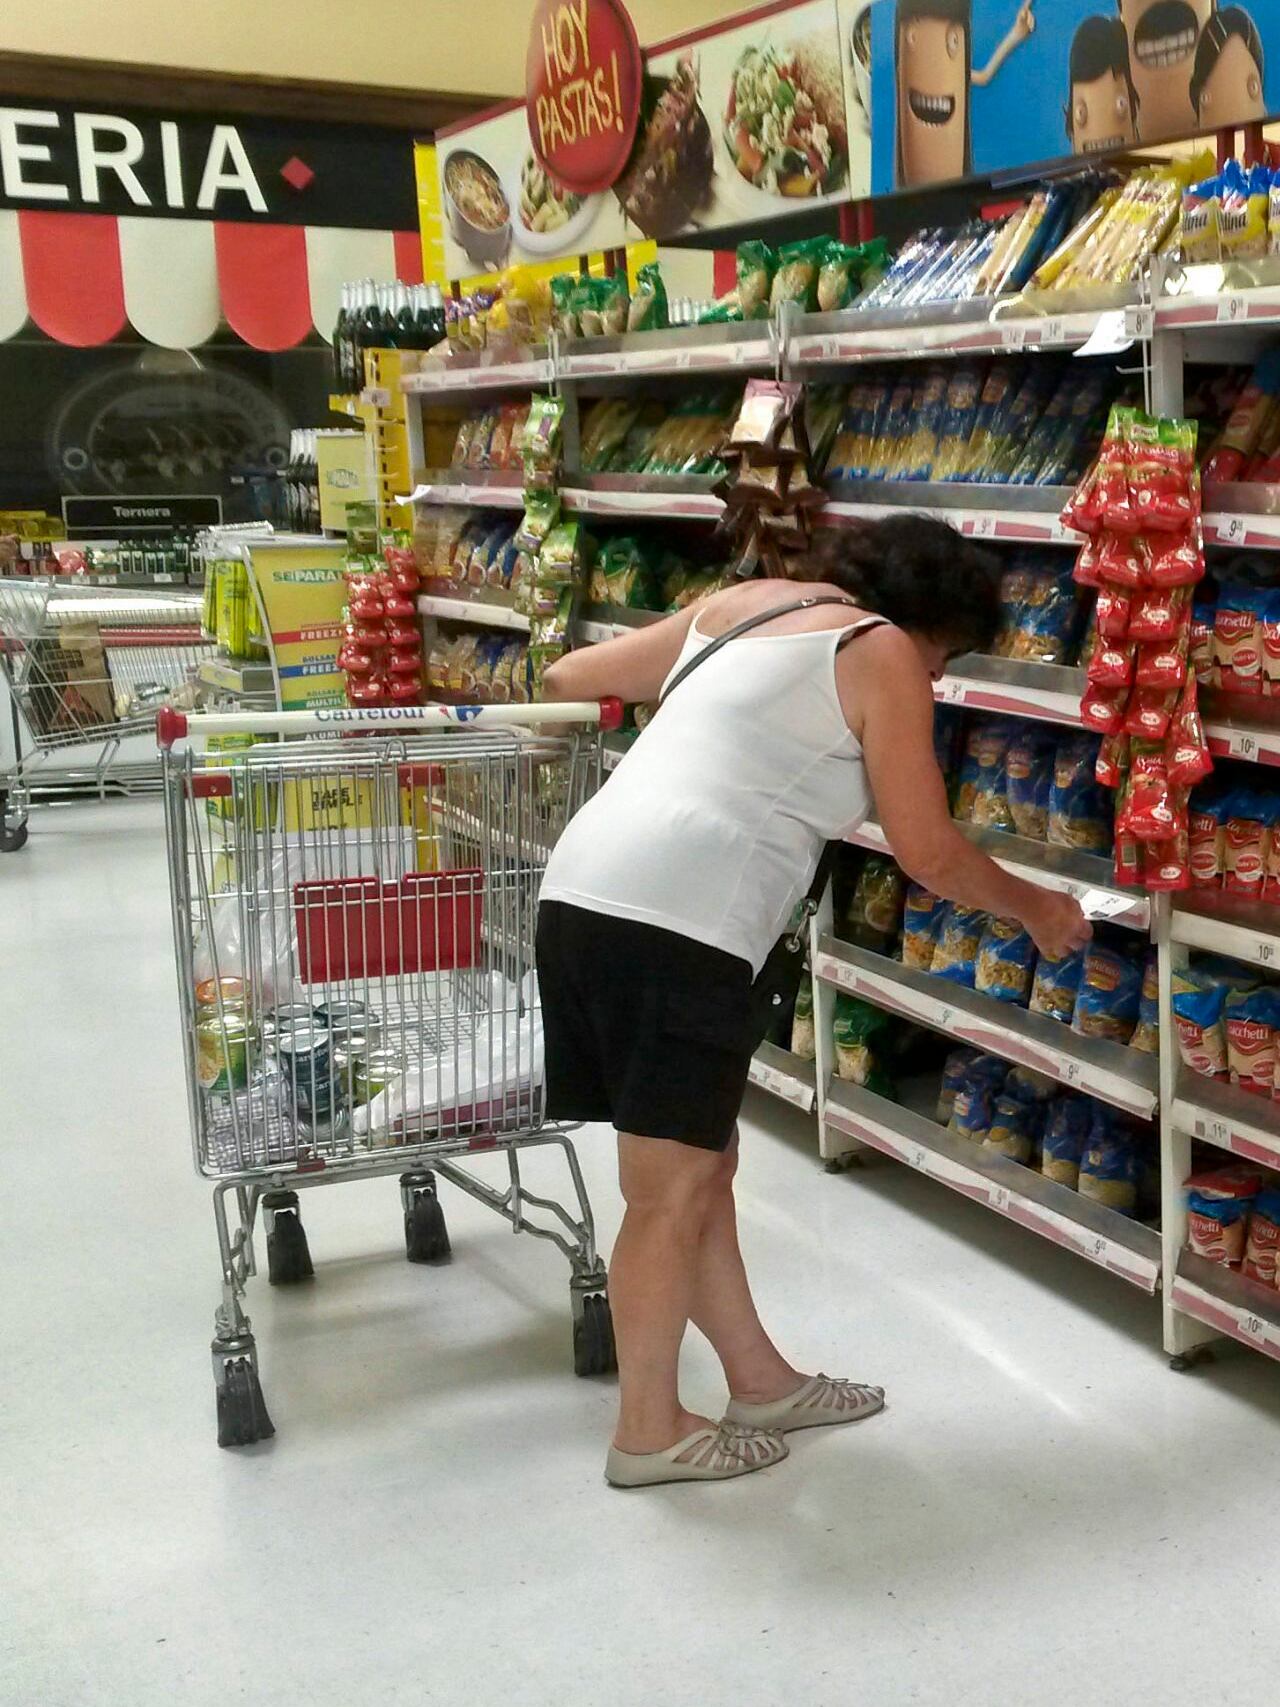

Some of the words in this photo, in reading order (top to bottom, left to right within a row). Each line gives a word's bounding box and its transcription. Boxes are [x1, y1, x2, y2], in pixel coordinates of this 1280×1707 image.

[542, 0, 590, 90] HOY
[536, 49, 624, 158] PASTAS!
[0, 106, 269, 213] ERIA
[113, 506, 171, 518] Ternera
[272, 569, 340, 583] SEPARA
[301, 629, 343, 641] FREEZ
[303, 663, 342, 675] FREEZ
[305, 730, 344, 741] ALUMI
